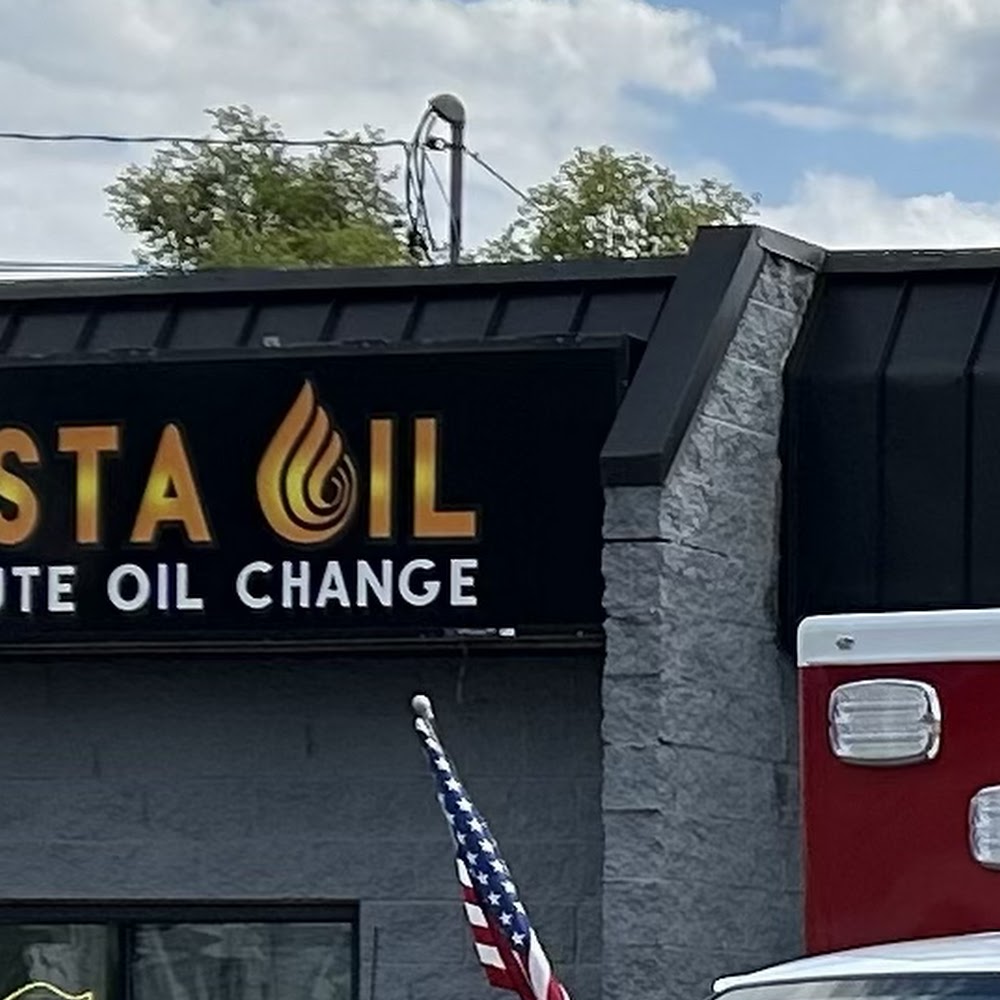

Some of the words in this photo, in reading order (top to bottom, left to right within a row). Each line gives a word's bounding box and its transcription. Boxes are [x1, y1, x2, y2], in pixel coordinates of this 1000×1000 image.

[0, 564, 76, 612] TE
[107, 563, 204, 611] OIL
[236, 558, 479, 609] CHANGE
